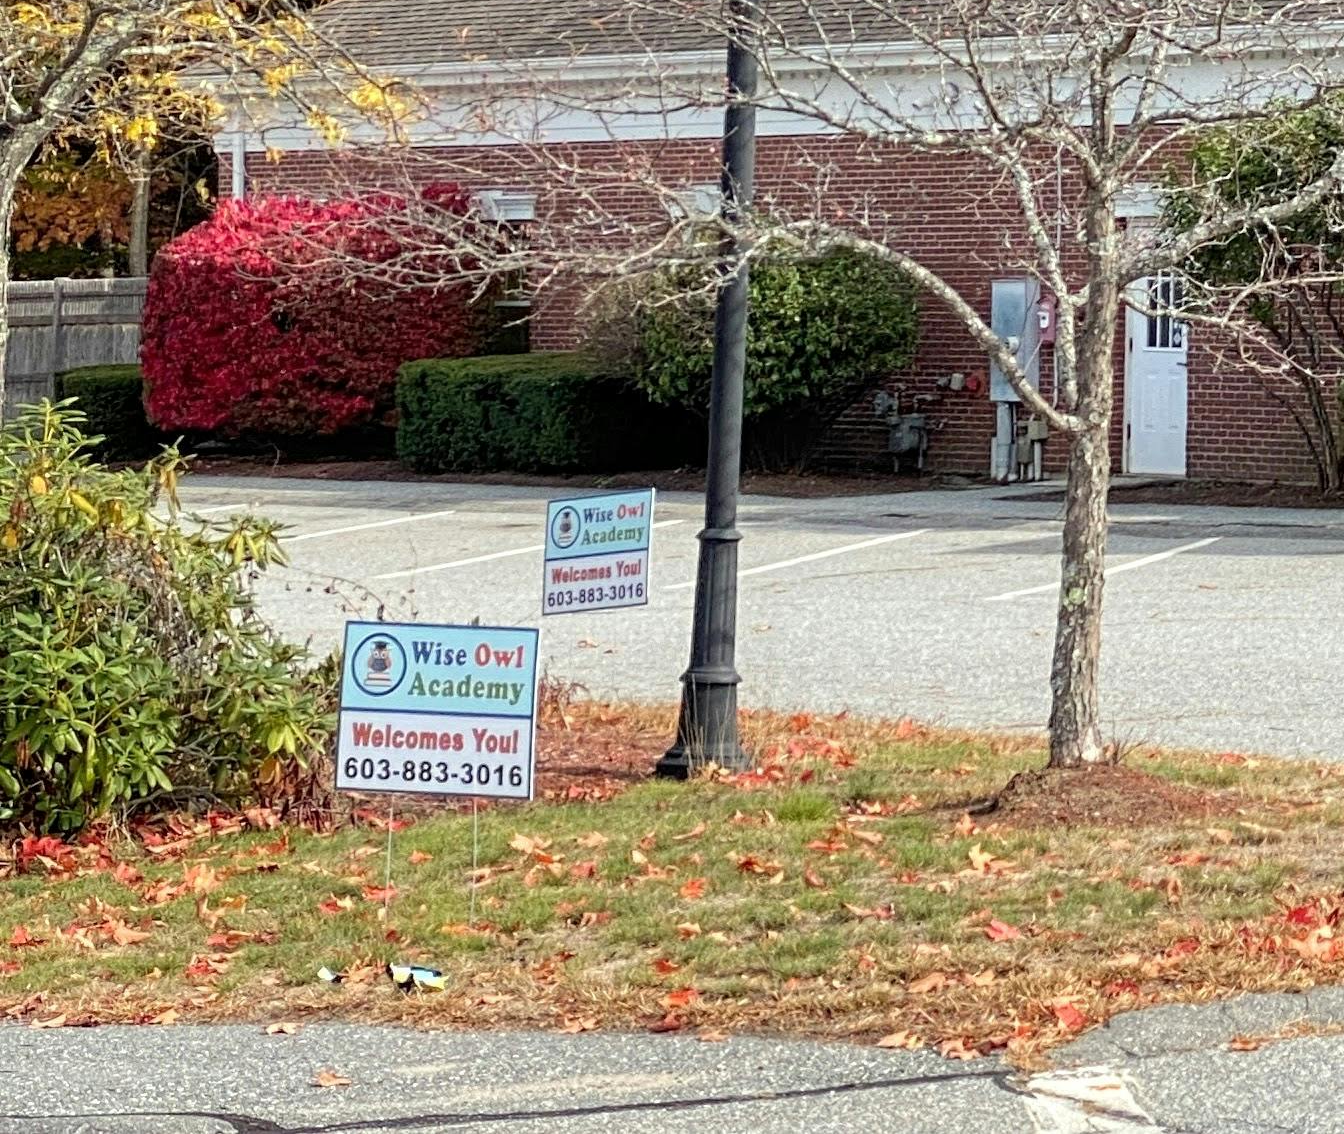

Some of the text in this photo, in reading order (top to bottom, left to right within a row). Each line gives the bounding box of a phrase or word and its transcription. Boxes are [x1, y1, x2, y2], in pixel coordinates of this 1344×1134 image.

[583, 502, 645, 523] Wise Owl
[581, 526, 645, 546] Academy
[551, 559, 642, 584] Welcomes You!
[548, 582, 643, 607] 603-883-3016
[412, 641, 524, 668] Wise Owl
[407, 672, 526, 705] Academy
[352, 722, 519, 754] Welcomes You!
[344, 757, 522, 787] 603-883-3016
